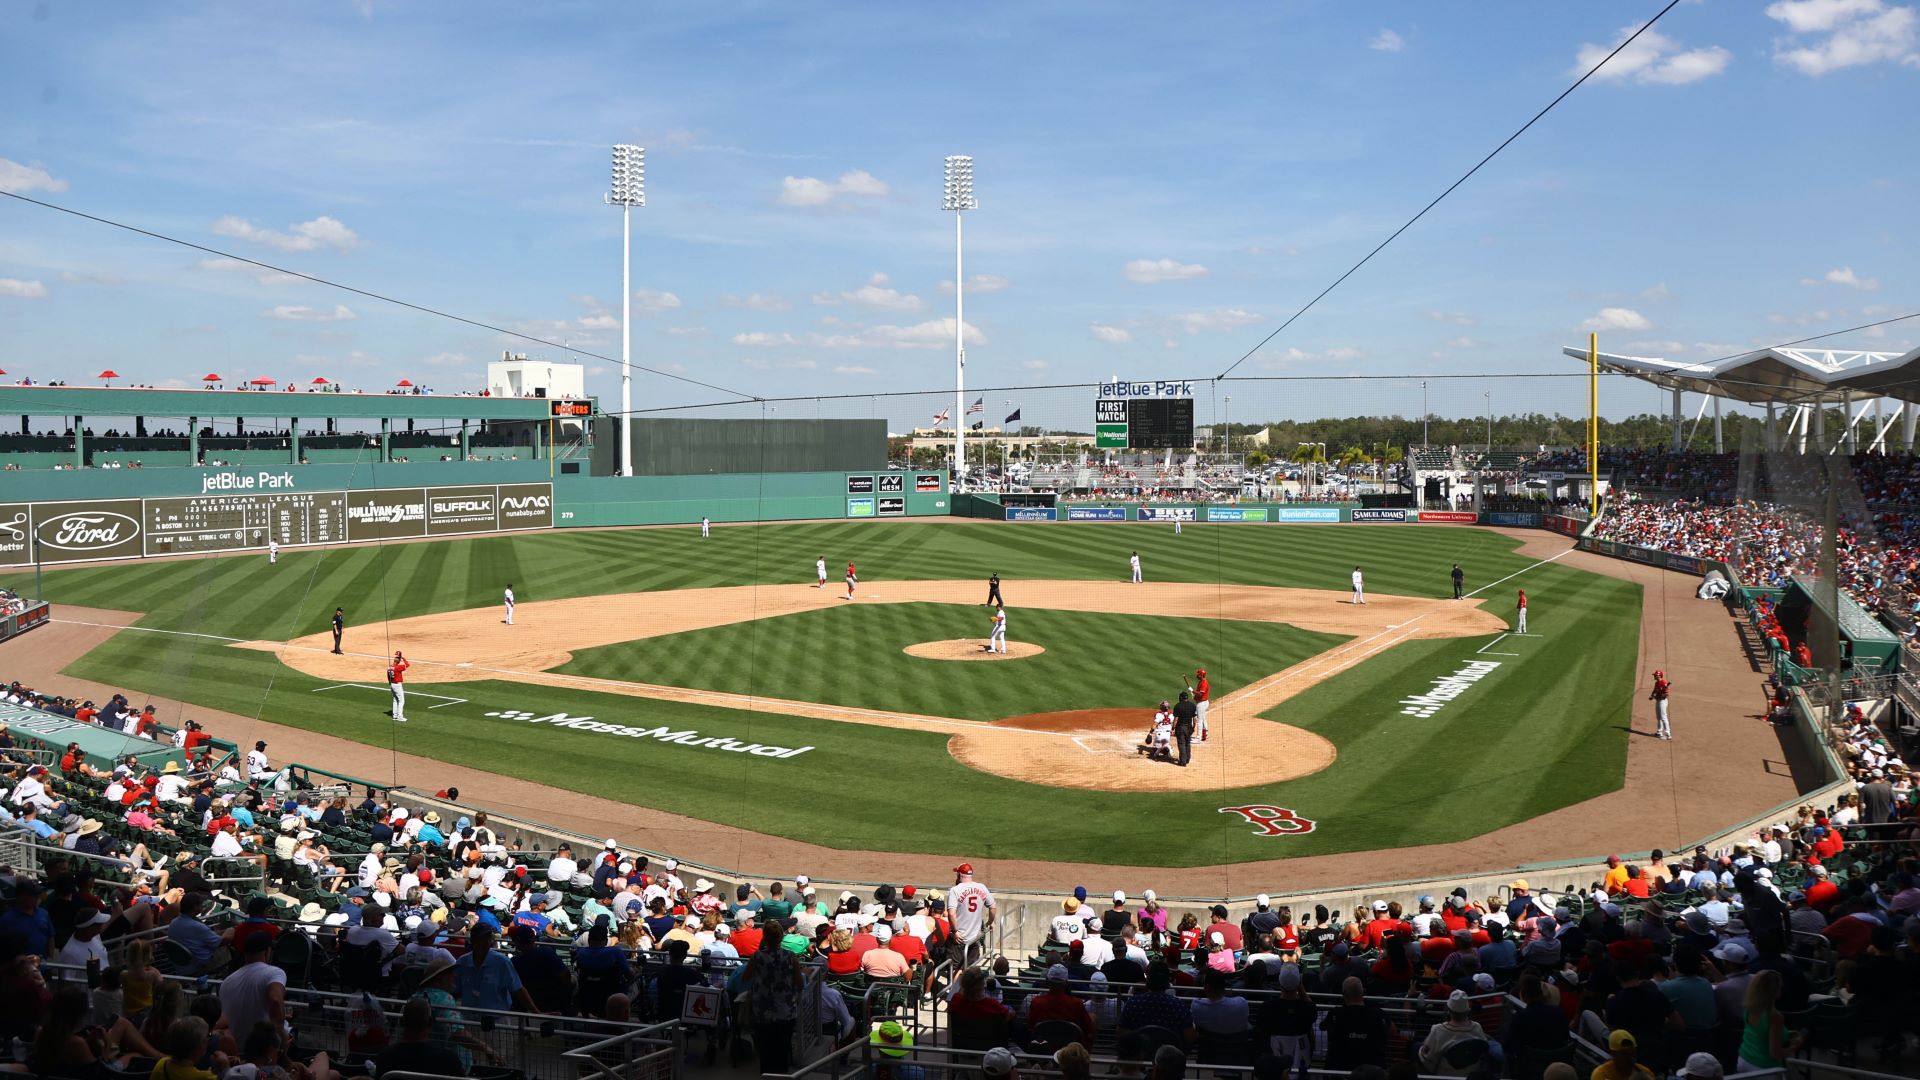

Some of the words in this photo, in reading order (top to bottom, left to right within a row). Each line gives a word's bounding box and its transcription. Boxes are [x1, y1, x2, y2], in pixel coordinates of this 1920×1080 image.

[1098, 381, 1150, 399] jetBlue
[1155, 380, 1191, 396] Park
[555, 404, 589, 415] HOOTERS
[1099, 402, 1124, 411] FIRST
[1096, 411, 1126, 421] WATCH
[202, 472, 255, 494] jetBlue
[258, 471, 295, 489] Park
[190, 497, 256, 506] AMERICAN
[433, 500, 491, 513] SUFFOLK
[348, 501, 392, 518] SULLIVAN
[405, 503, 425, 515] TIRE
[505, 509, 546, 518] nunababy.com
[561, 511, 574, 519] 379
[1281, 510, 1337, 518] BunionPain.com
[1353, 510, 1380, 519] SAMUEL
[1380, 510, 1404, 519] ADAMS
[55, 517, 121, 544] Ford
[1399, 659, 1502, 708] MassMutual
[529, 712, 816, 759] MassMutual
[246, 755, 256, 766] 53
[967, 896, 978, 913] 5
[1056, 920, 1071, 928] Park
[1317, 933, 1335, 942] HARPER
[1183, 938, 1191, 950] 7
